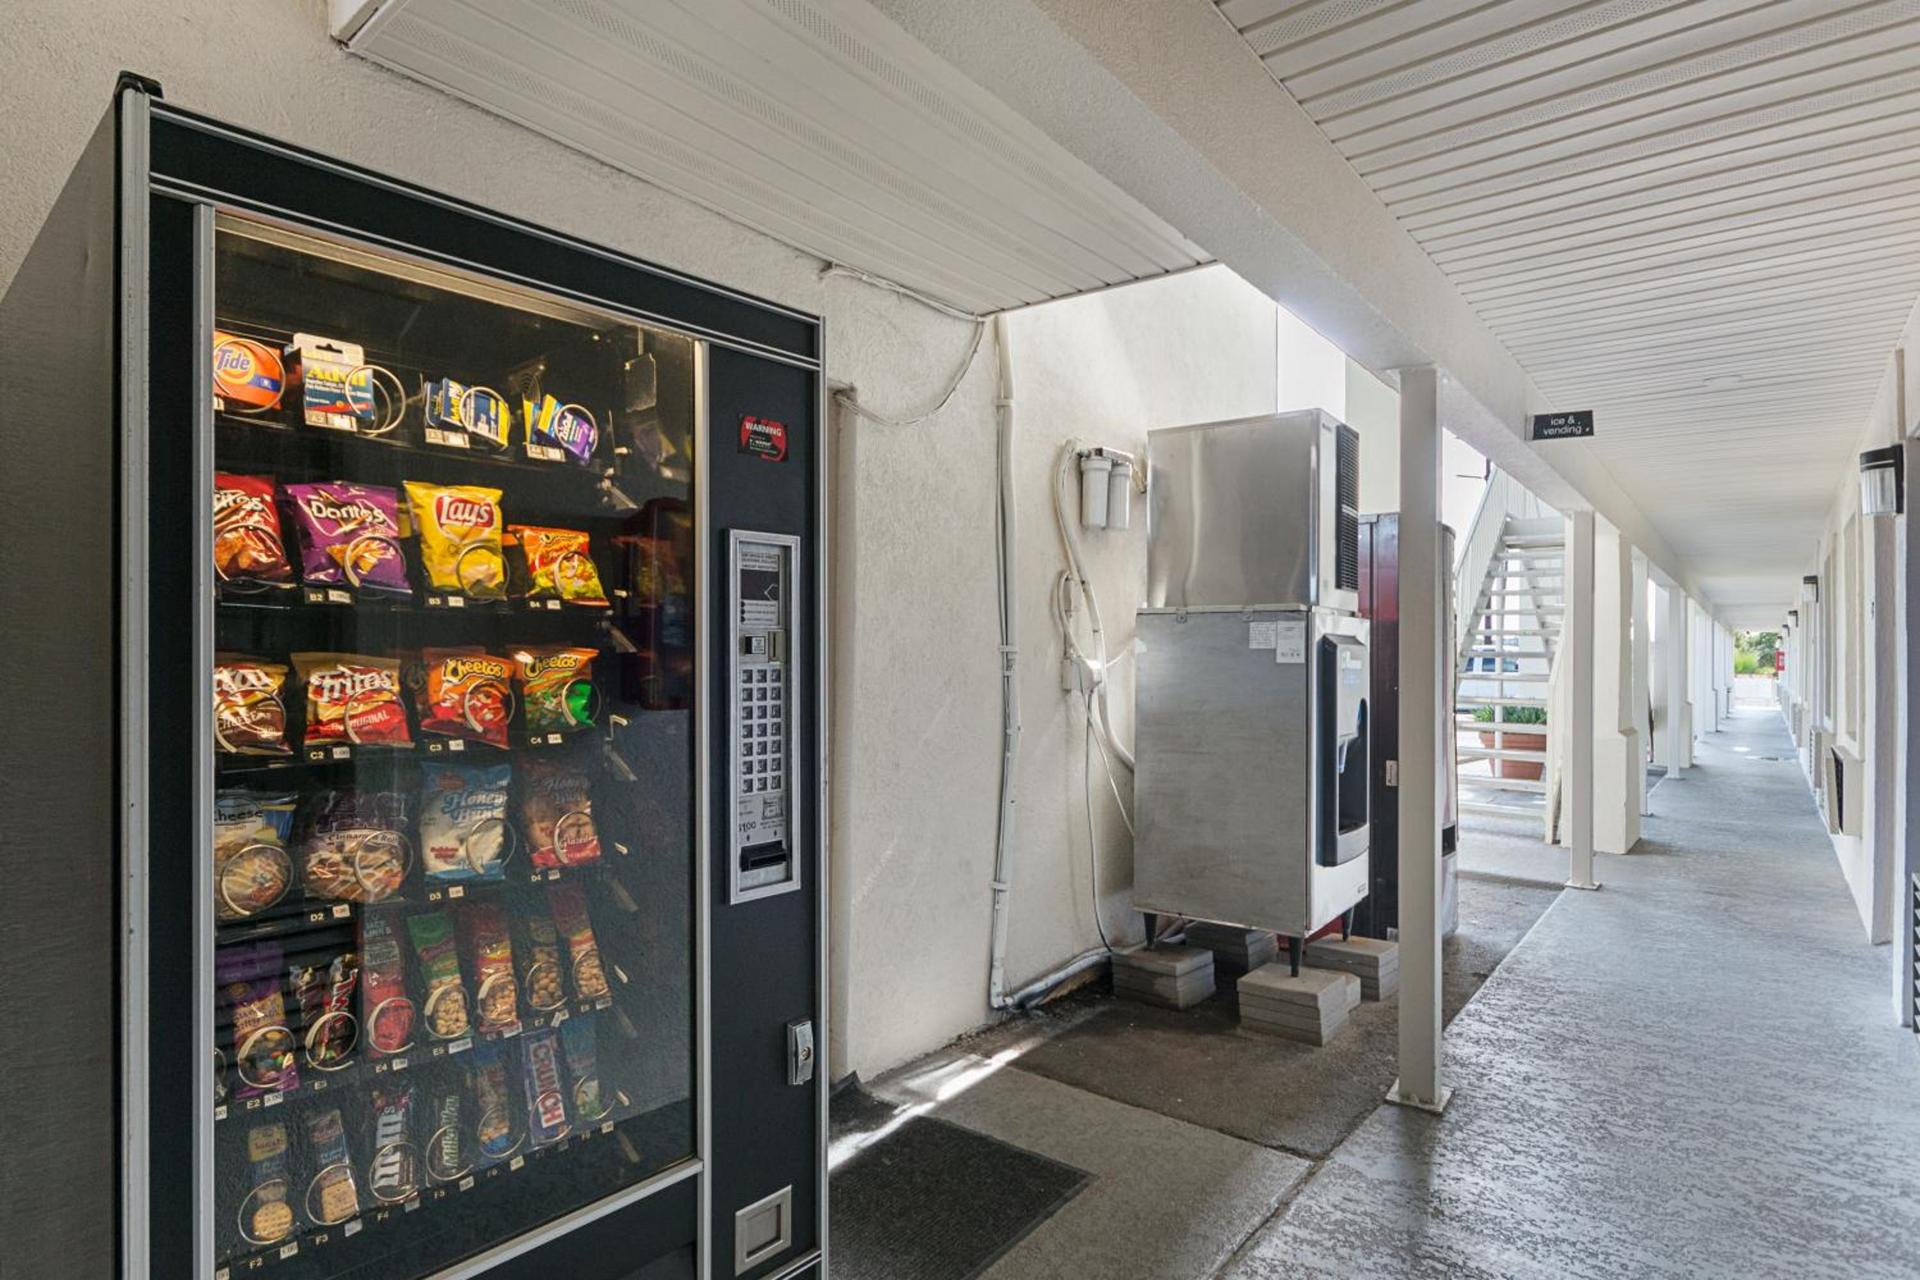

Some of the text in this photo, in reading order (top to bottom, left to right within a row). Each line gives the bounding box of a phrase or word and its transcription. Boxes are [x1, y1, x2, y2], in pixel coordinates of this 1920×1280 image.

[217, 348, 250, 371] Tide
[1551, 415, 1575, 426] ice &
[745, 422, 782, 437] WARNING
[1543, 424, 1582, 436] vending
[311, 500, 386, 523] Doritos
[445, 658, 503, 682] Cheetos
[524, 656, 578, 678] Cheetos
[310, 667, 392, 704] Fritos
[350, 711, 391, 728] RIGINAL
[310, 751, 324, 760] C2
[442, 789, 508, 813] Honey
[214, 808, 263, 821] heese
[310, 912, 325, 922] D2
[532, 1042, 562, 1124] CRUNCH
[247, 1098, 261, 1110] E2
[249, 1257, 262, 1270] F2
